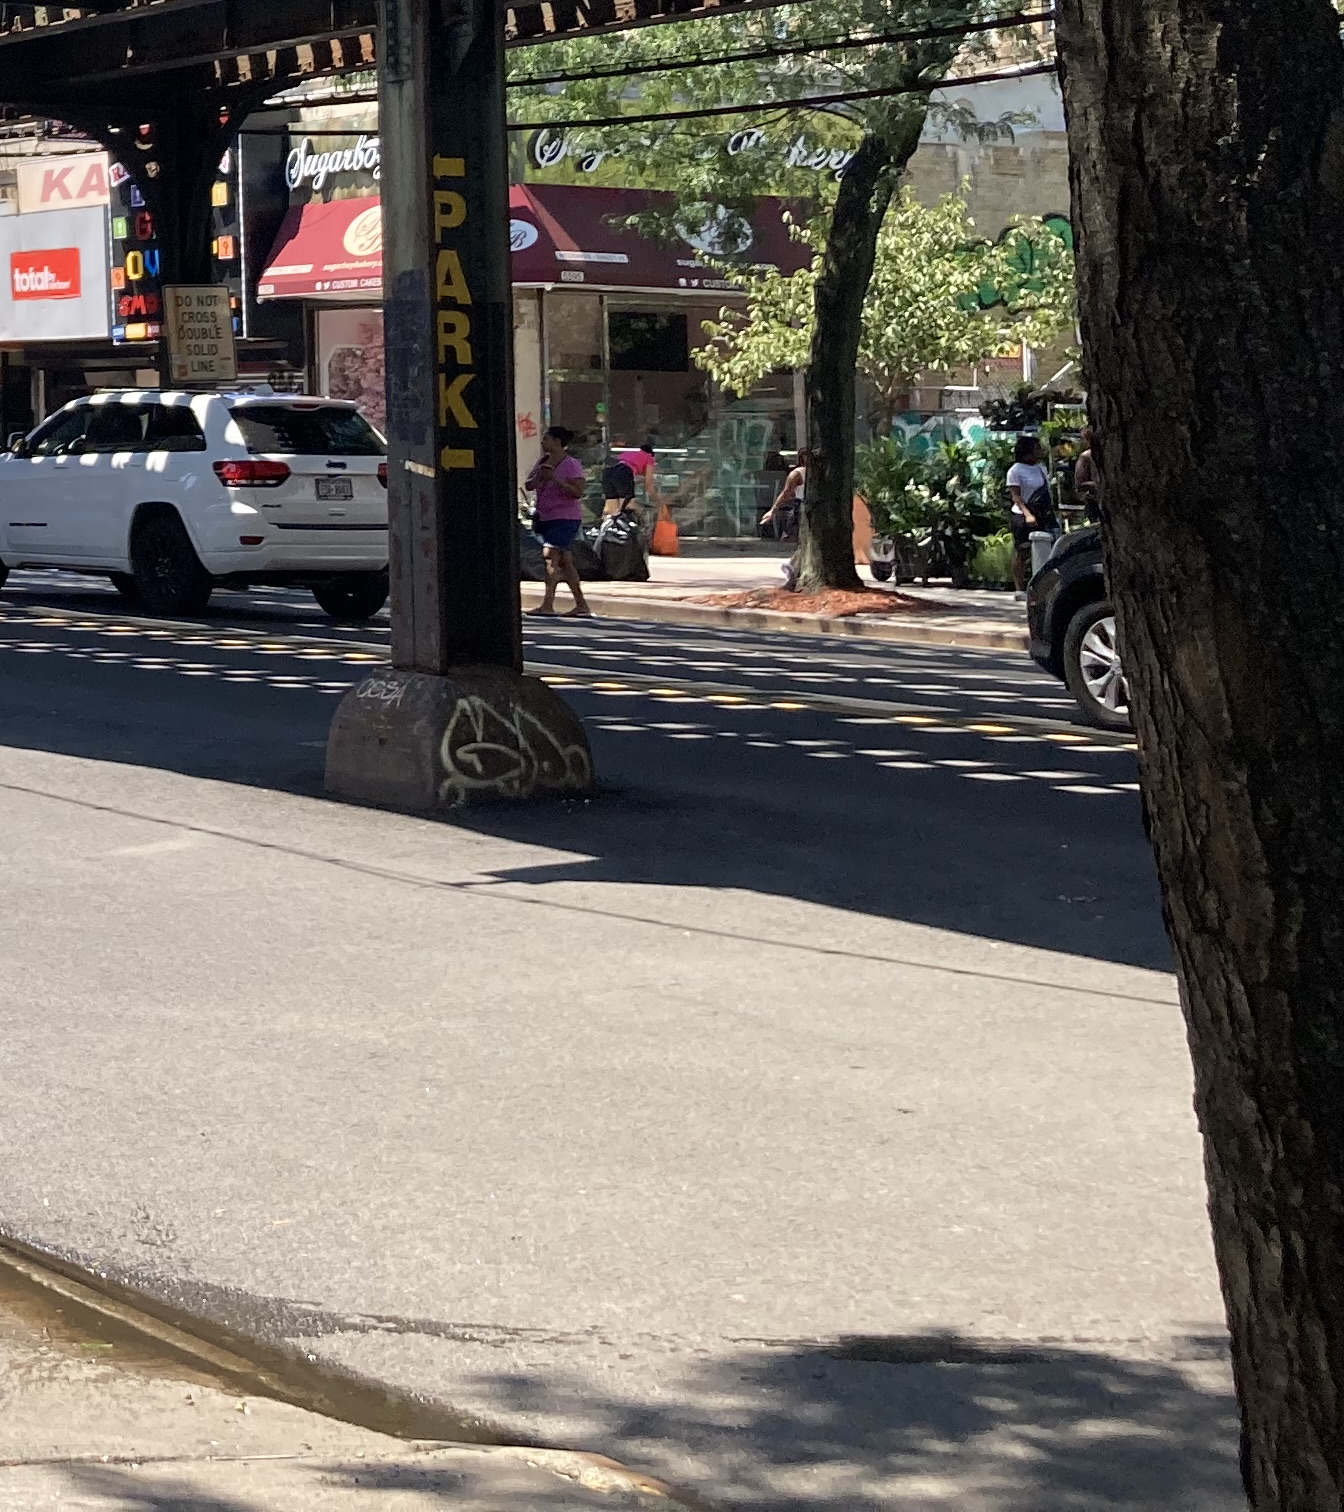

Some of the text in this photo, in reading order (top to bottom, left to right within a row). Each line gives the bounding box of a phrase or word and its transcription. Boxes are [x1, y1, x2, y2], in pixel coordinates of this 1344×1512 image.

[286, 135, 381, 191] Sugarbo
[14, 265, 49, 292] total
[175, 295, 218, 307] DO NOT
[433, 190, 479, 428] PARK
[181, 311, 218, 323] CROSS
[178, 327, 223, 340] DOUBLE
[186, 344, 218, 356] SOLID
[191, 360, 215, 372] LINE
